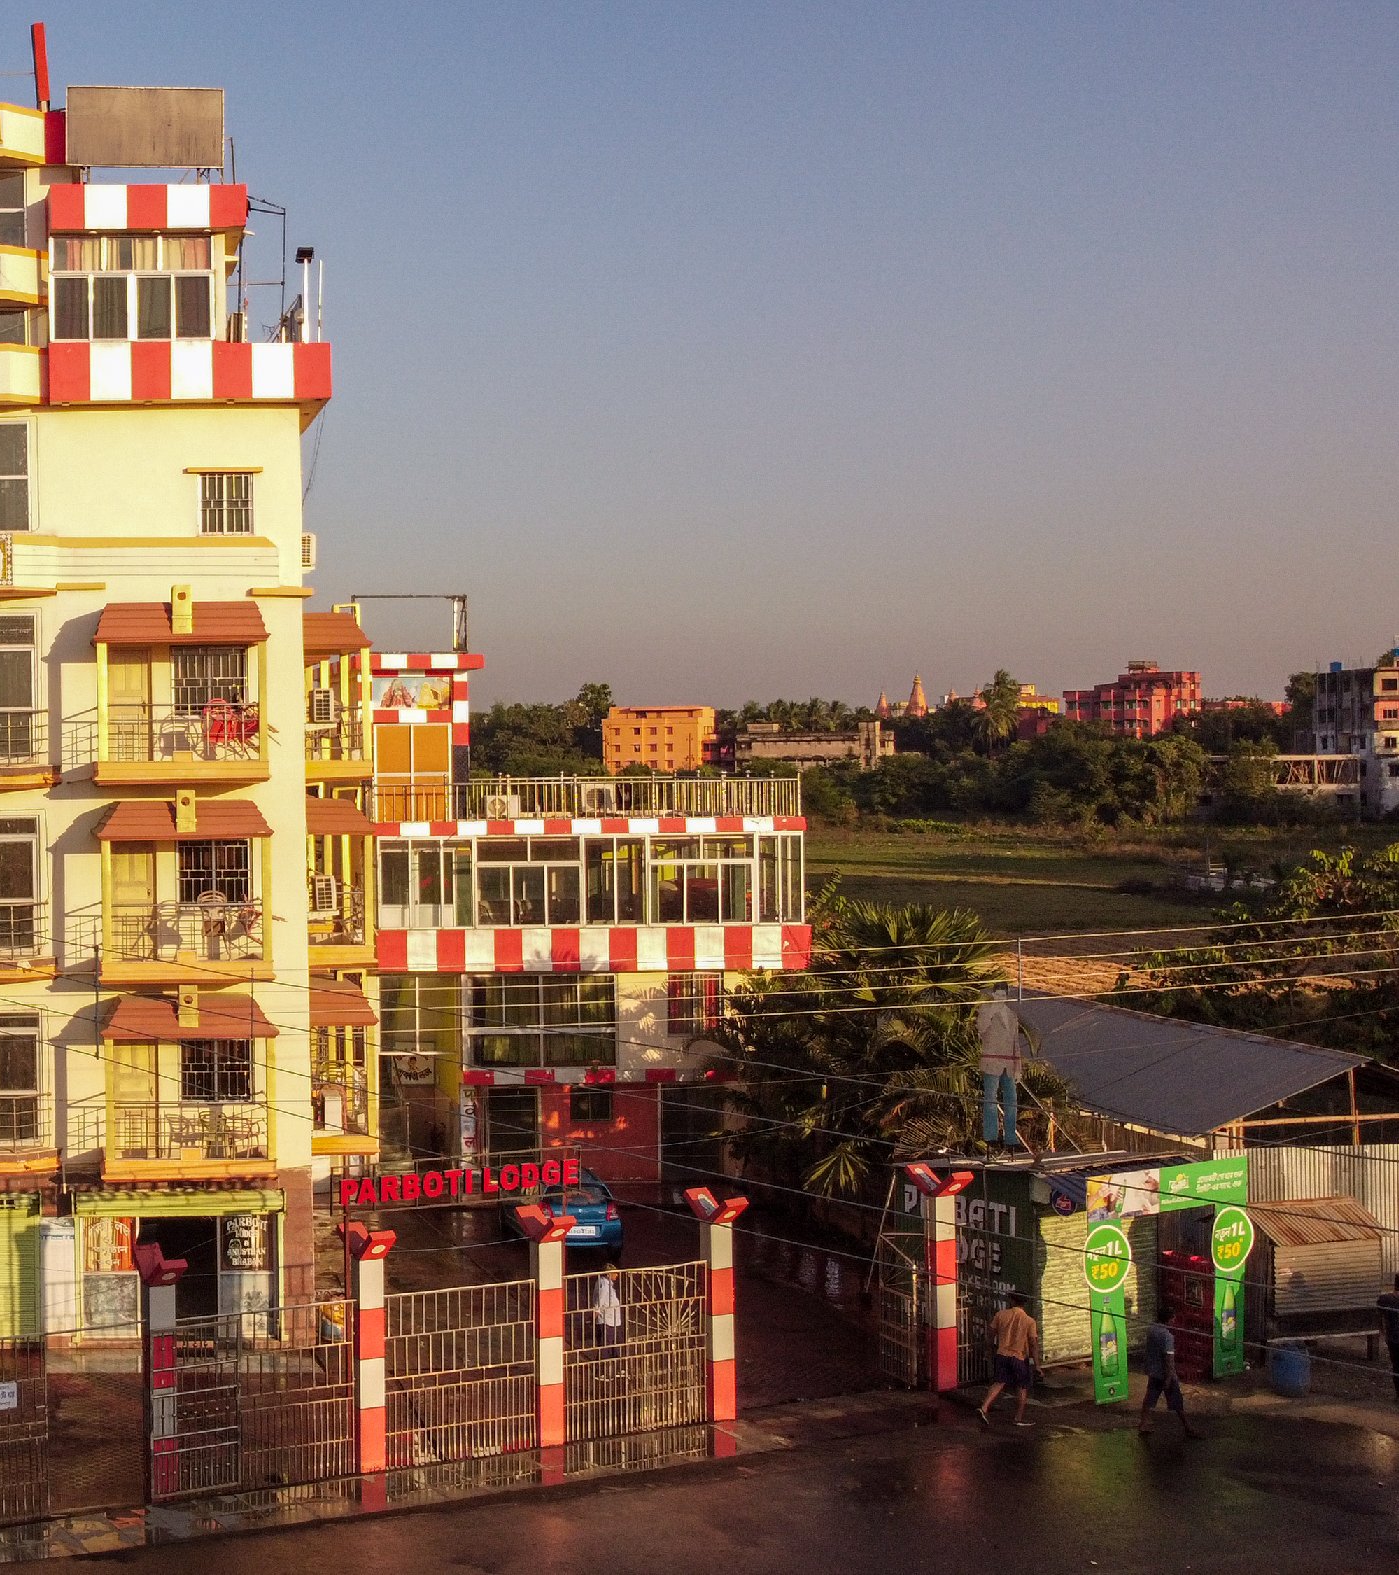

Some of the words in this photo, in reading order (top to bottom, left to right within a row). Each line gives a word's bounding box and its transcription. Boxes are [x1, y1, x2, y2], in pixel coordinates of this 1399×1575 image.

[339, 1168, 473, 1206] PARBOTI
[482, 1159, 579, 1192] LODGE
[904, 1184, 1016, 1237] PBATI
[1231, 1221, 1246, 1237] 1L
[957, 1234, 1001, 1273] DGE
[1106, 1240, 1122, 1256] 1L
